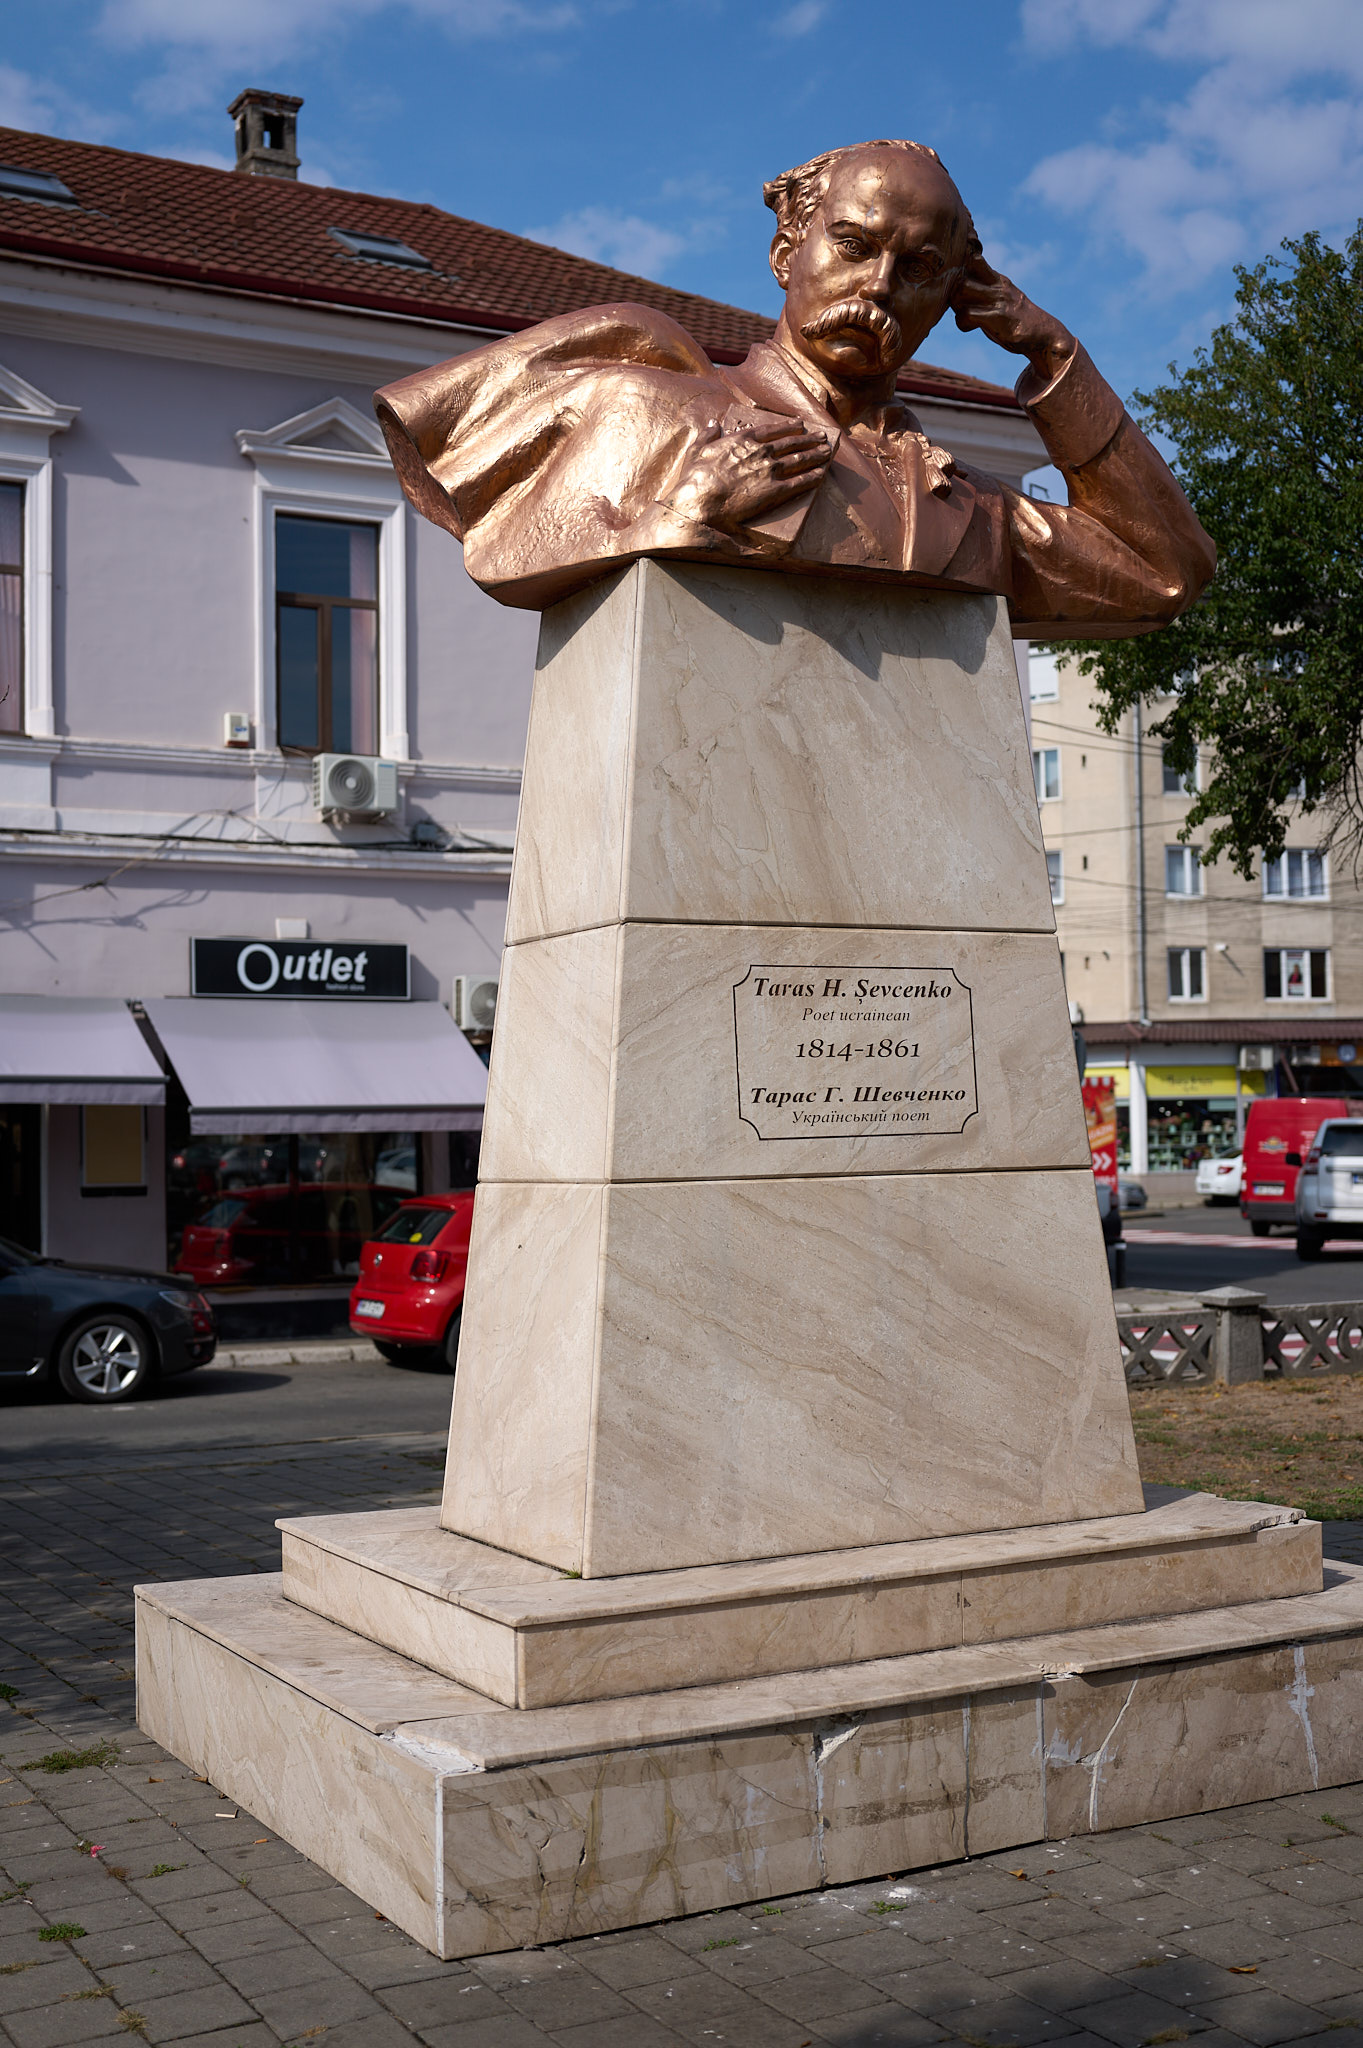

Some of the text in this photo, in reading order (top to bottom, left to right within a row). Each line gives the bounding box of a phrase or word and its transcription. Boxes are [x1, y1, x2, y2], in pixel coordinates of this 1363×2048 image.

[237, 943, 368, 992] Outlet
[753, 977, 815, 997] Taras
[822, 978, 847, 998] H.
[801, 1007, 911, 1021] Poet ucrainean
[795, 1038, 920, 1062] 1814-1861
[751, 1086, 966, 1108] Тарас Г. Шевченко
[791, 1110, 930, 1127] Український поет
